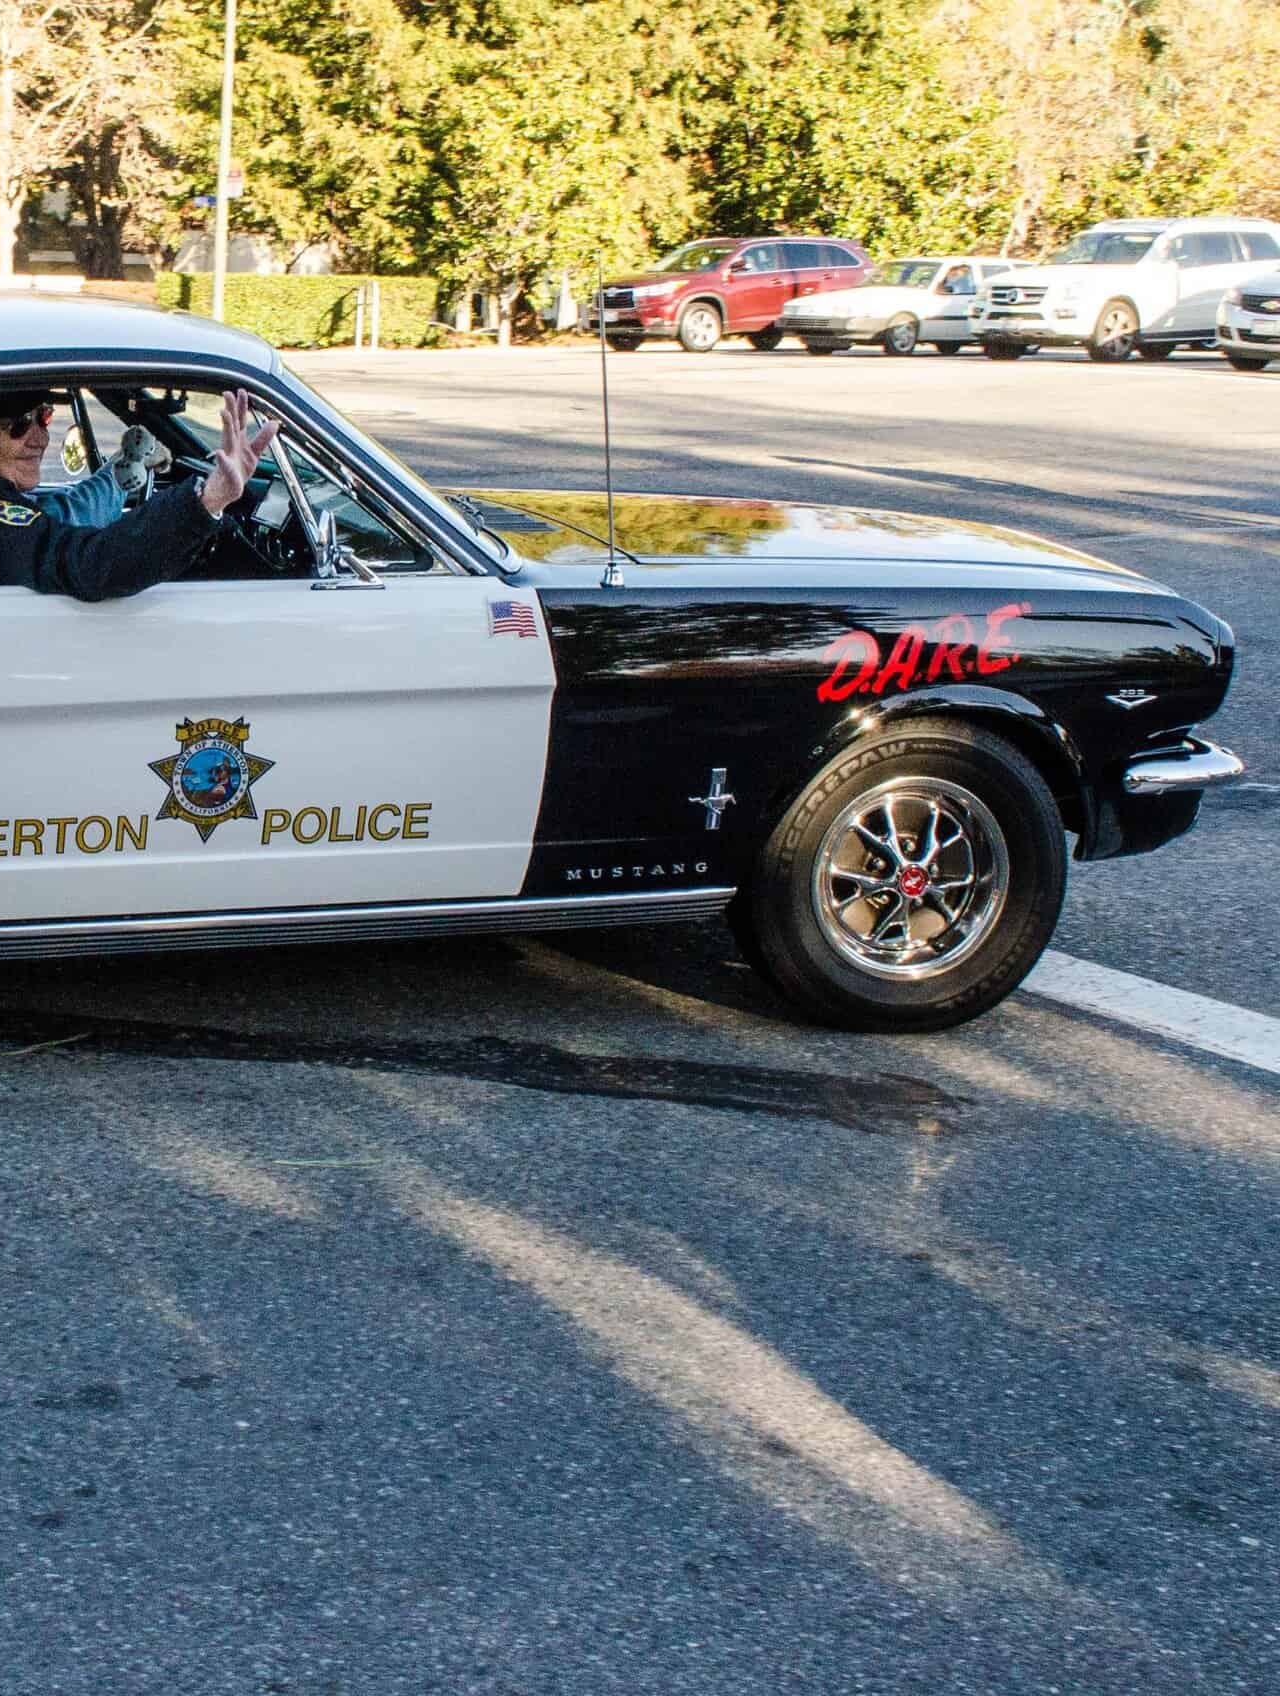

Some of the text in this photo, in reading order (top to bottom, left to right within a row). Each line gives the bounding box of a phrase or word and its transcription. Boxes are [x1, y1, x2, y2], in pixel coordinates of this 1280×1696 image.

[186, 720, 241, 738] POLICE
[260, 803, 433, 846] POLICE
[566, 862, 709, 881] MUSTANG
